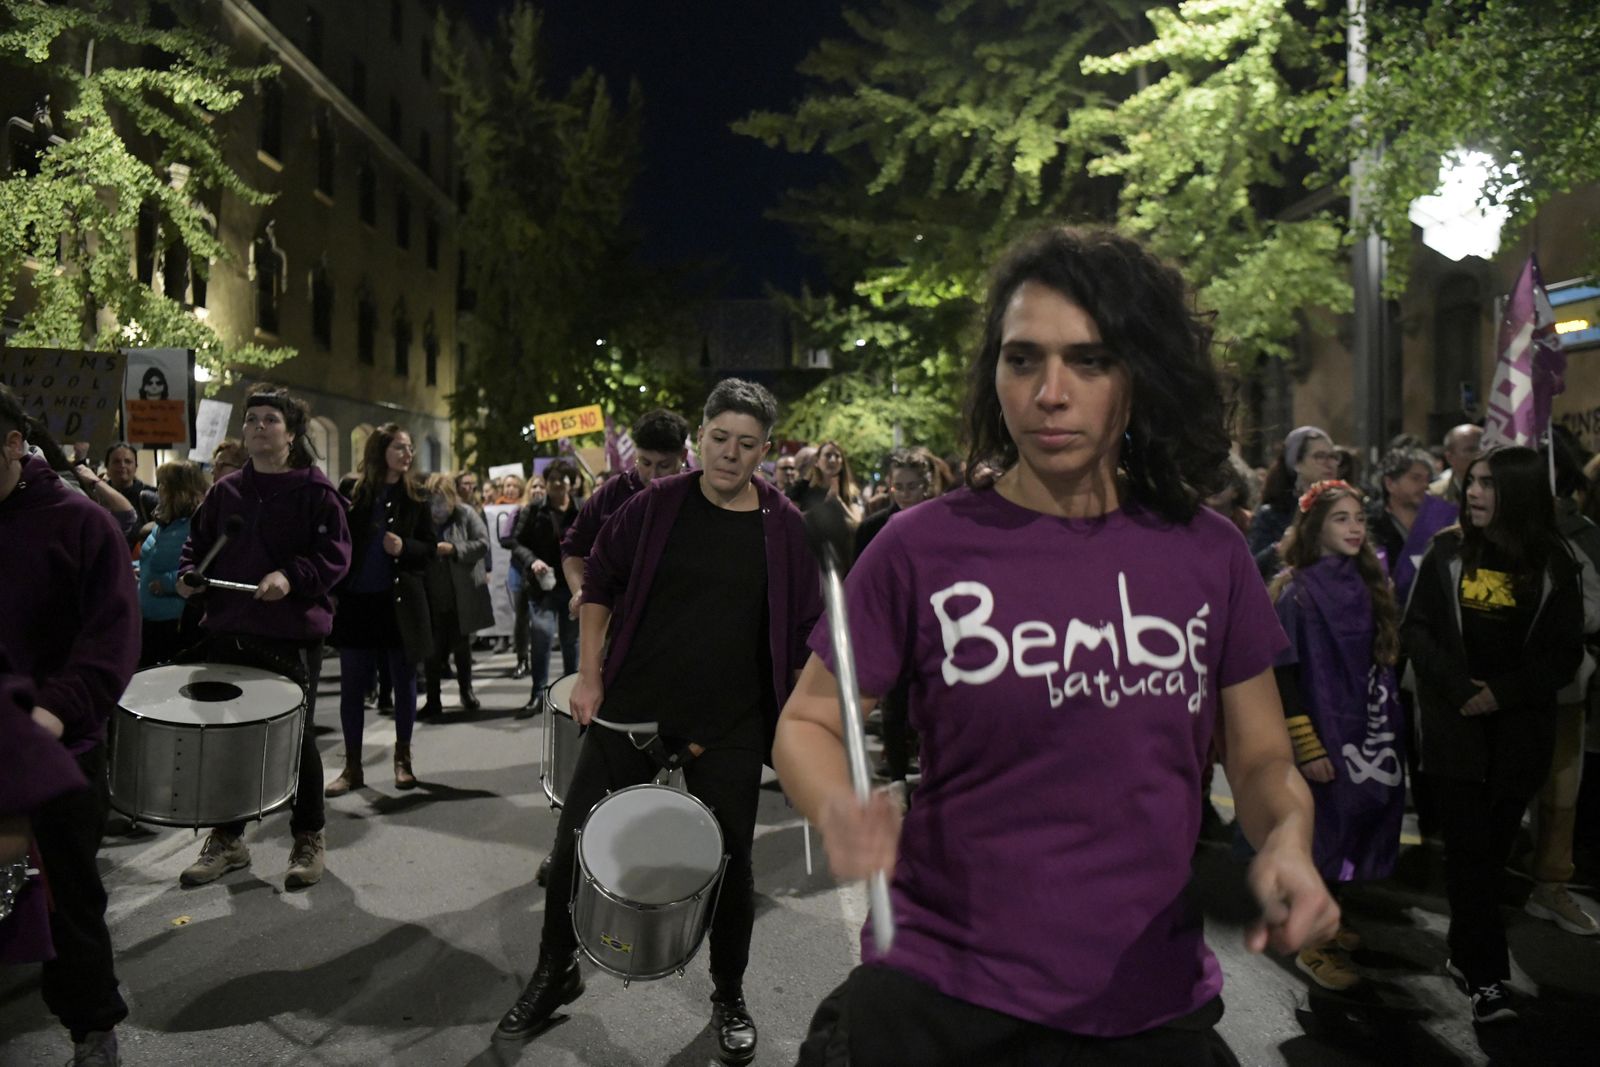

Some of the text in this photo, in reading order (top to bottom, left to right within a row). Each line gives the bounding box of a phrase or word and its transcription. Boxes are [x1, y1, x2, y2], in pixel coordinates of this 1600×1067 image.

[538, 410, 597, 438] NO ES NO
[929, 571, 1211, 687] Bembé
